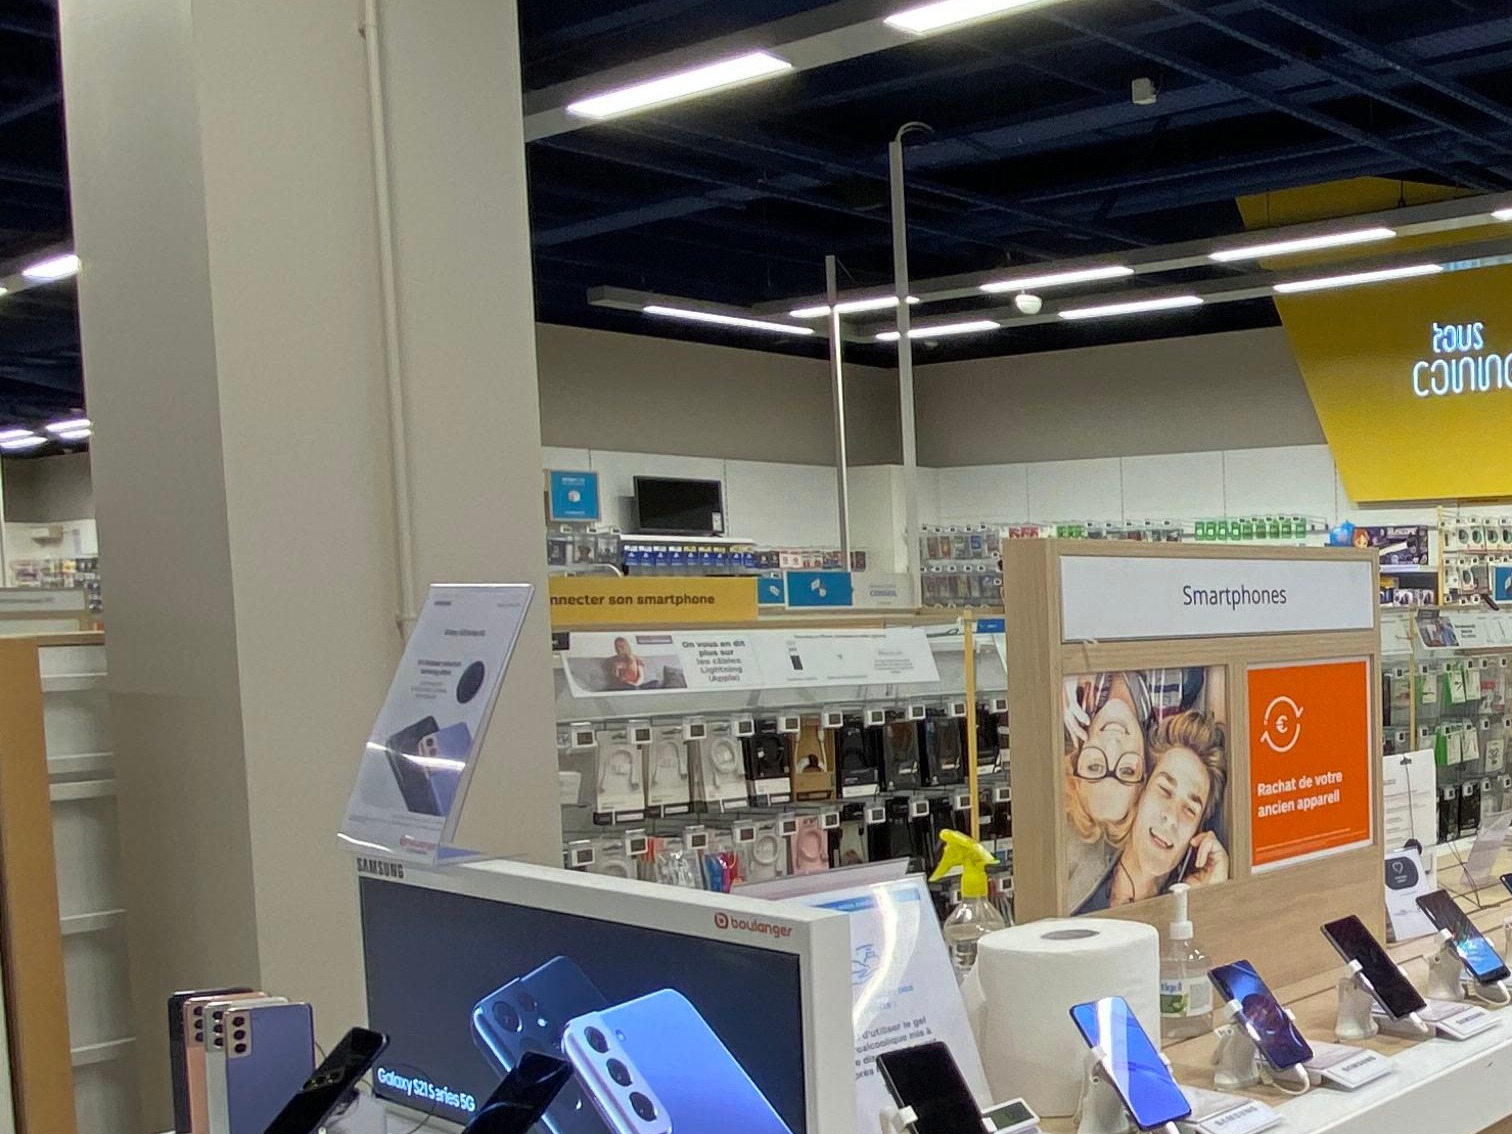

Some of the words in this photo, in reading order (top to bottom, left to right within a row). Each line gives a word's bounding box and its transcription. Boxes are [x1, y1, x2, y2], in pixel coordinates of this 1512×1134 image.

[1432, 322, 1484, 353] tous
[550, 594, 604, 606] nnecter
[608, 595, 633, 605] son
[637, 593, 715, 607] smartphone
[1182, 584, 1287, 611] Smartphones
[1257, 778, 1297, 797] Rachat
[1299, 775, 1313, 790] de
[1315, 770, 1343, 786] votre
[1257, 798, 1296, 818] ancien
[1297, 788, 1340, 811] appareil
[356, 857, 404, 879] SAMSUNG
[730, 915, 793, 938] boulanger
[912, 1016, 926, 1028] gel
[377, 1067, 413, 1096] Galaxy
[413, 1078, 429, 1099] S21
[460, 1092, 476, 1112] 5G
